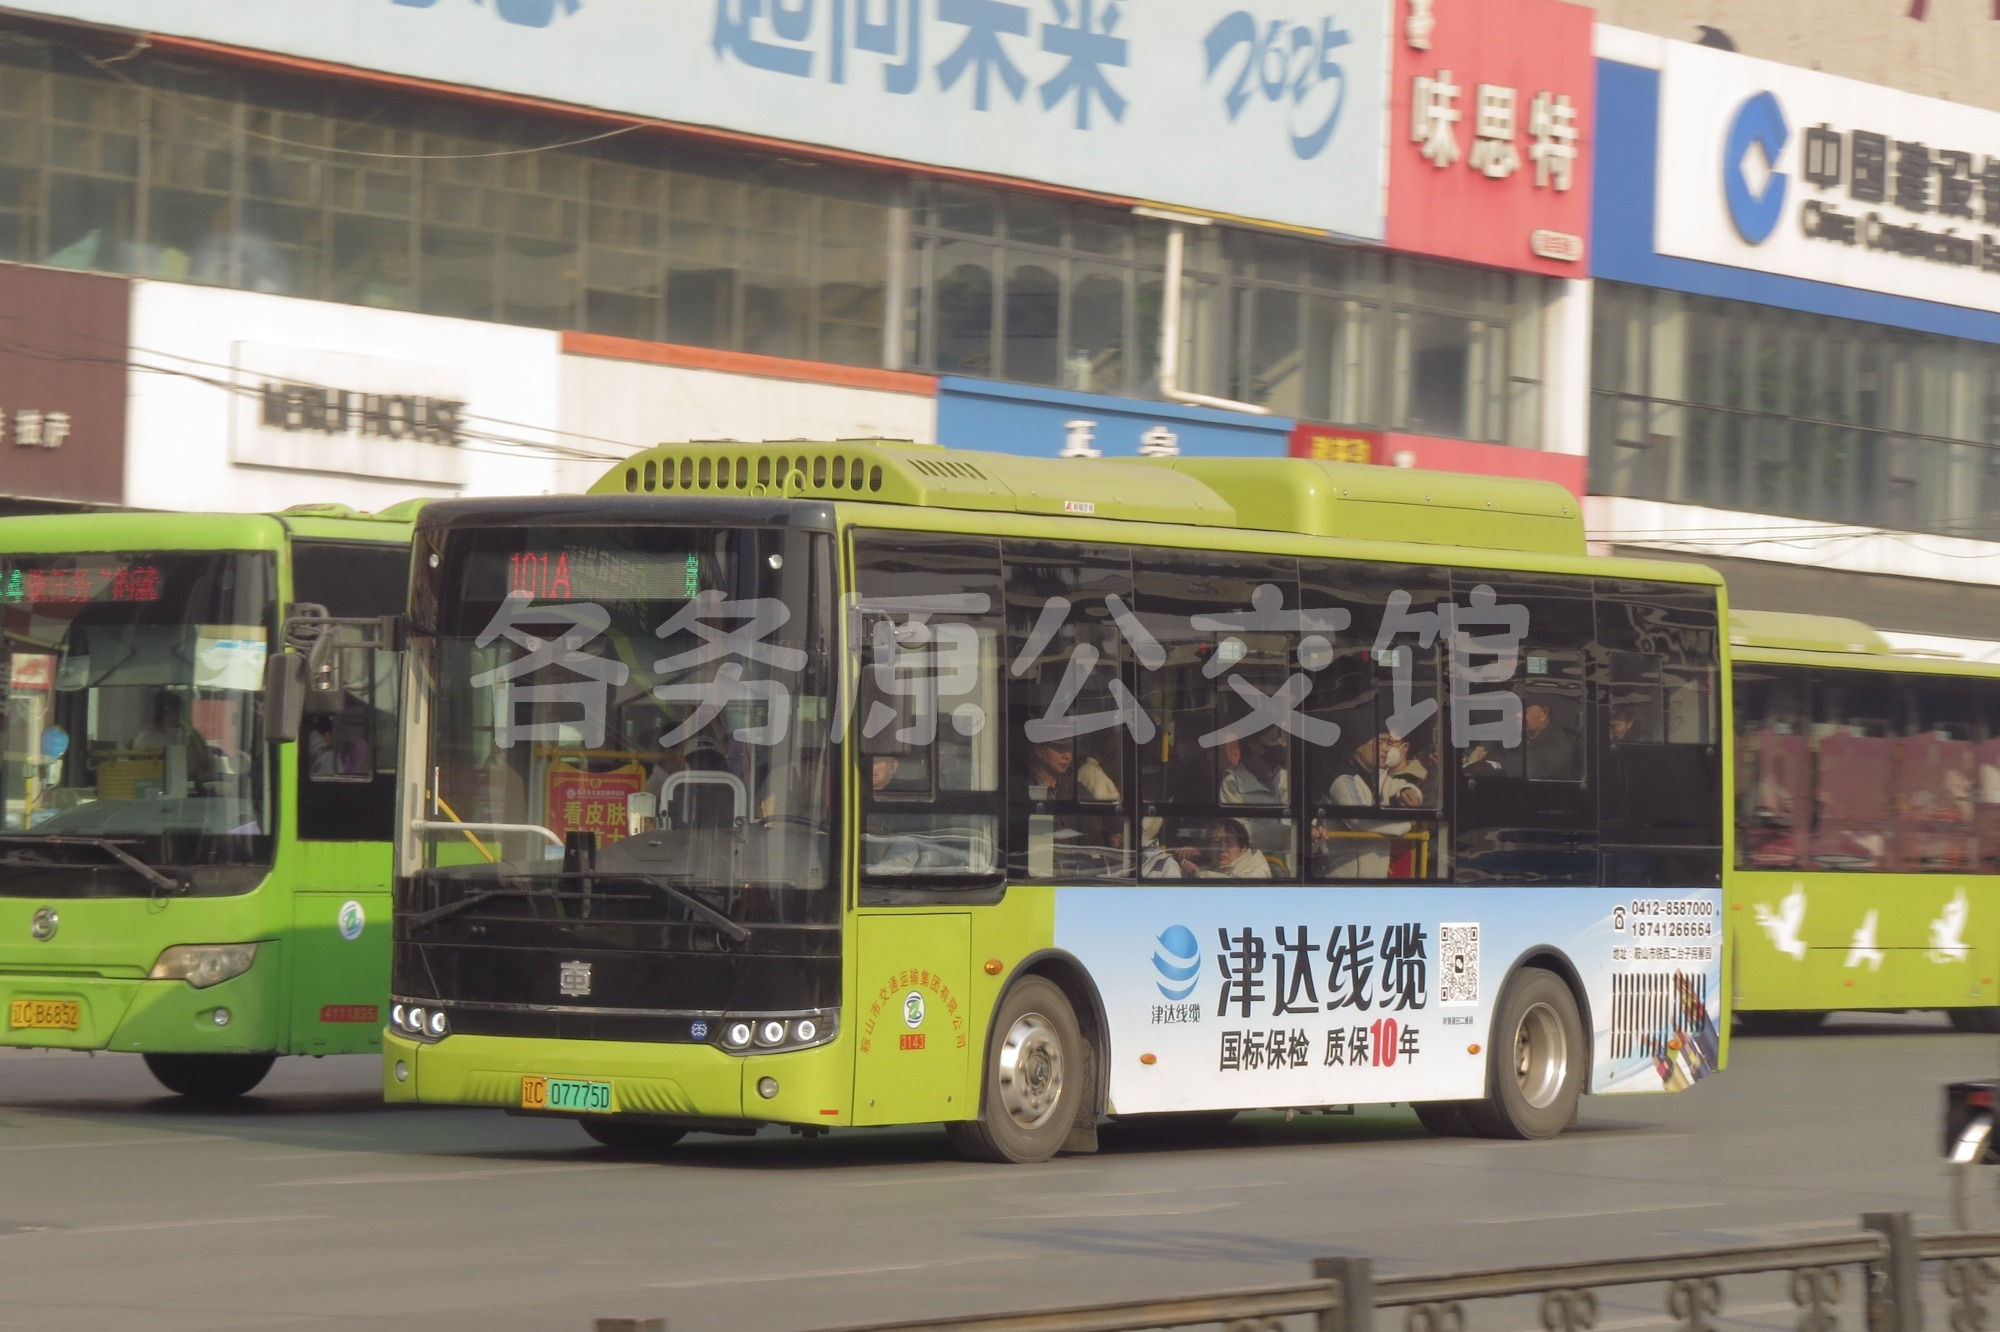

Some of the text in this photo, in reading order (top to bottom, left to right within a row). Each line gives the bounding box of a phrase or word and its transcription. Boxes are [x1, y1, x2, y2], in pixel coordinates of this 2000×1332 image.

[512, 552, 572, 599] 101A
[564, 801, 627, 826] 看皮肤
[1632, 901, 1713, 915] 0412-8587000
[1632, 922, 1711, 936] 18741266664
[1217, 923, 1428, 1018] 津达线缆
[860, 968, 966, 1053] 鞍山市交通运输集团有限公司
[1151, 1003, 1201, 1025] 津达线缆
[901, 1035, 925, 1049] 3143
[1219, 1017, 1420, 1072] 国标保检 质保10年
[524, 1081, 610, 1108] 辽C 07775D
